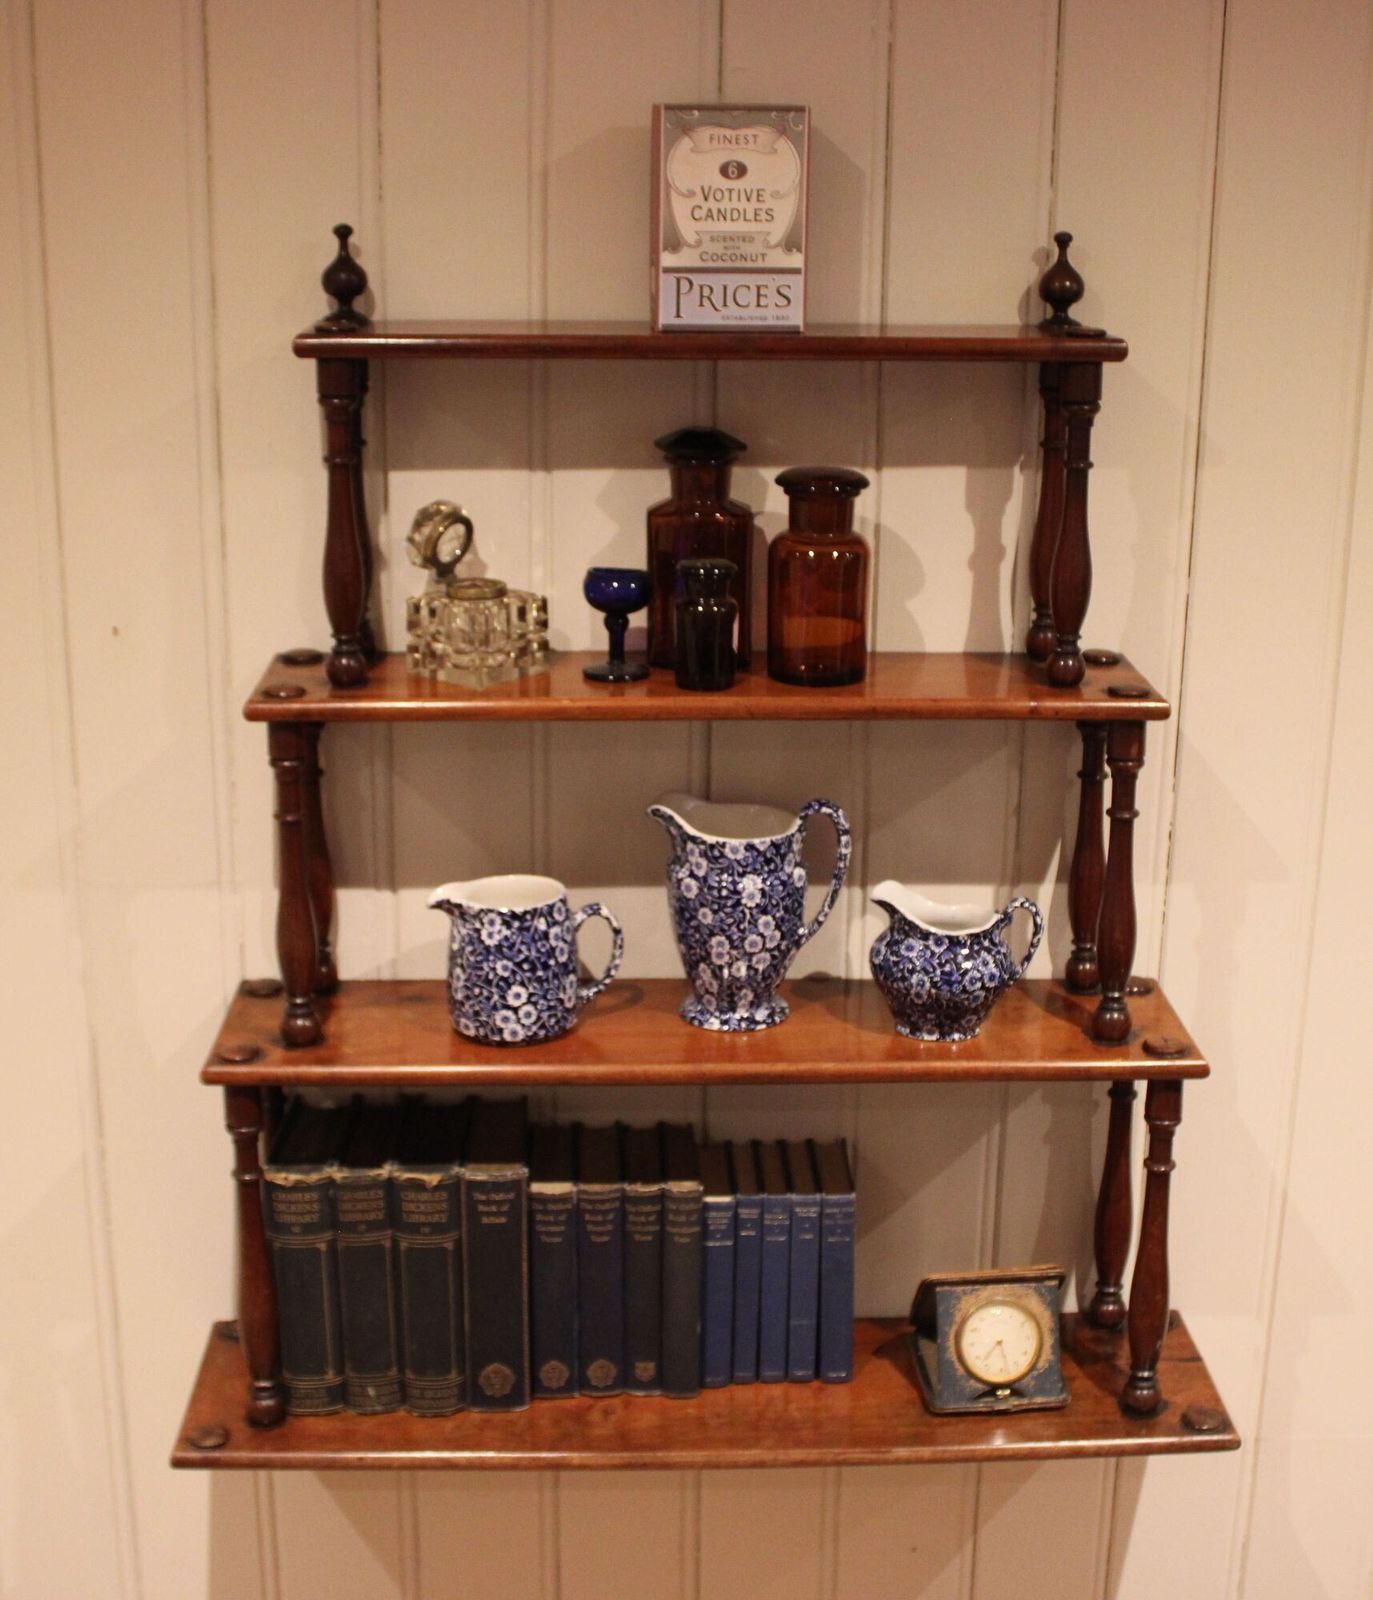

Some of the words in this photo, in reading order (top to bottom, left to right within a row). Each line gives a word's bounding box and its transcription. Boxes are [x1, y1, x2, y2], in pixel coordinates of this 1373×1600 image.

[708, 133, 759, 145] FINEST
[727, 161, 739, 178] 6
[700, 185, 766, 202] VOTIVE
[690, 205, 775, 222] CANDLES
[708, 235, 756, 243] SCENTED
[699, 251, 768, 263] COCONUT
